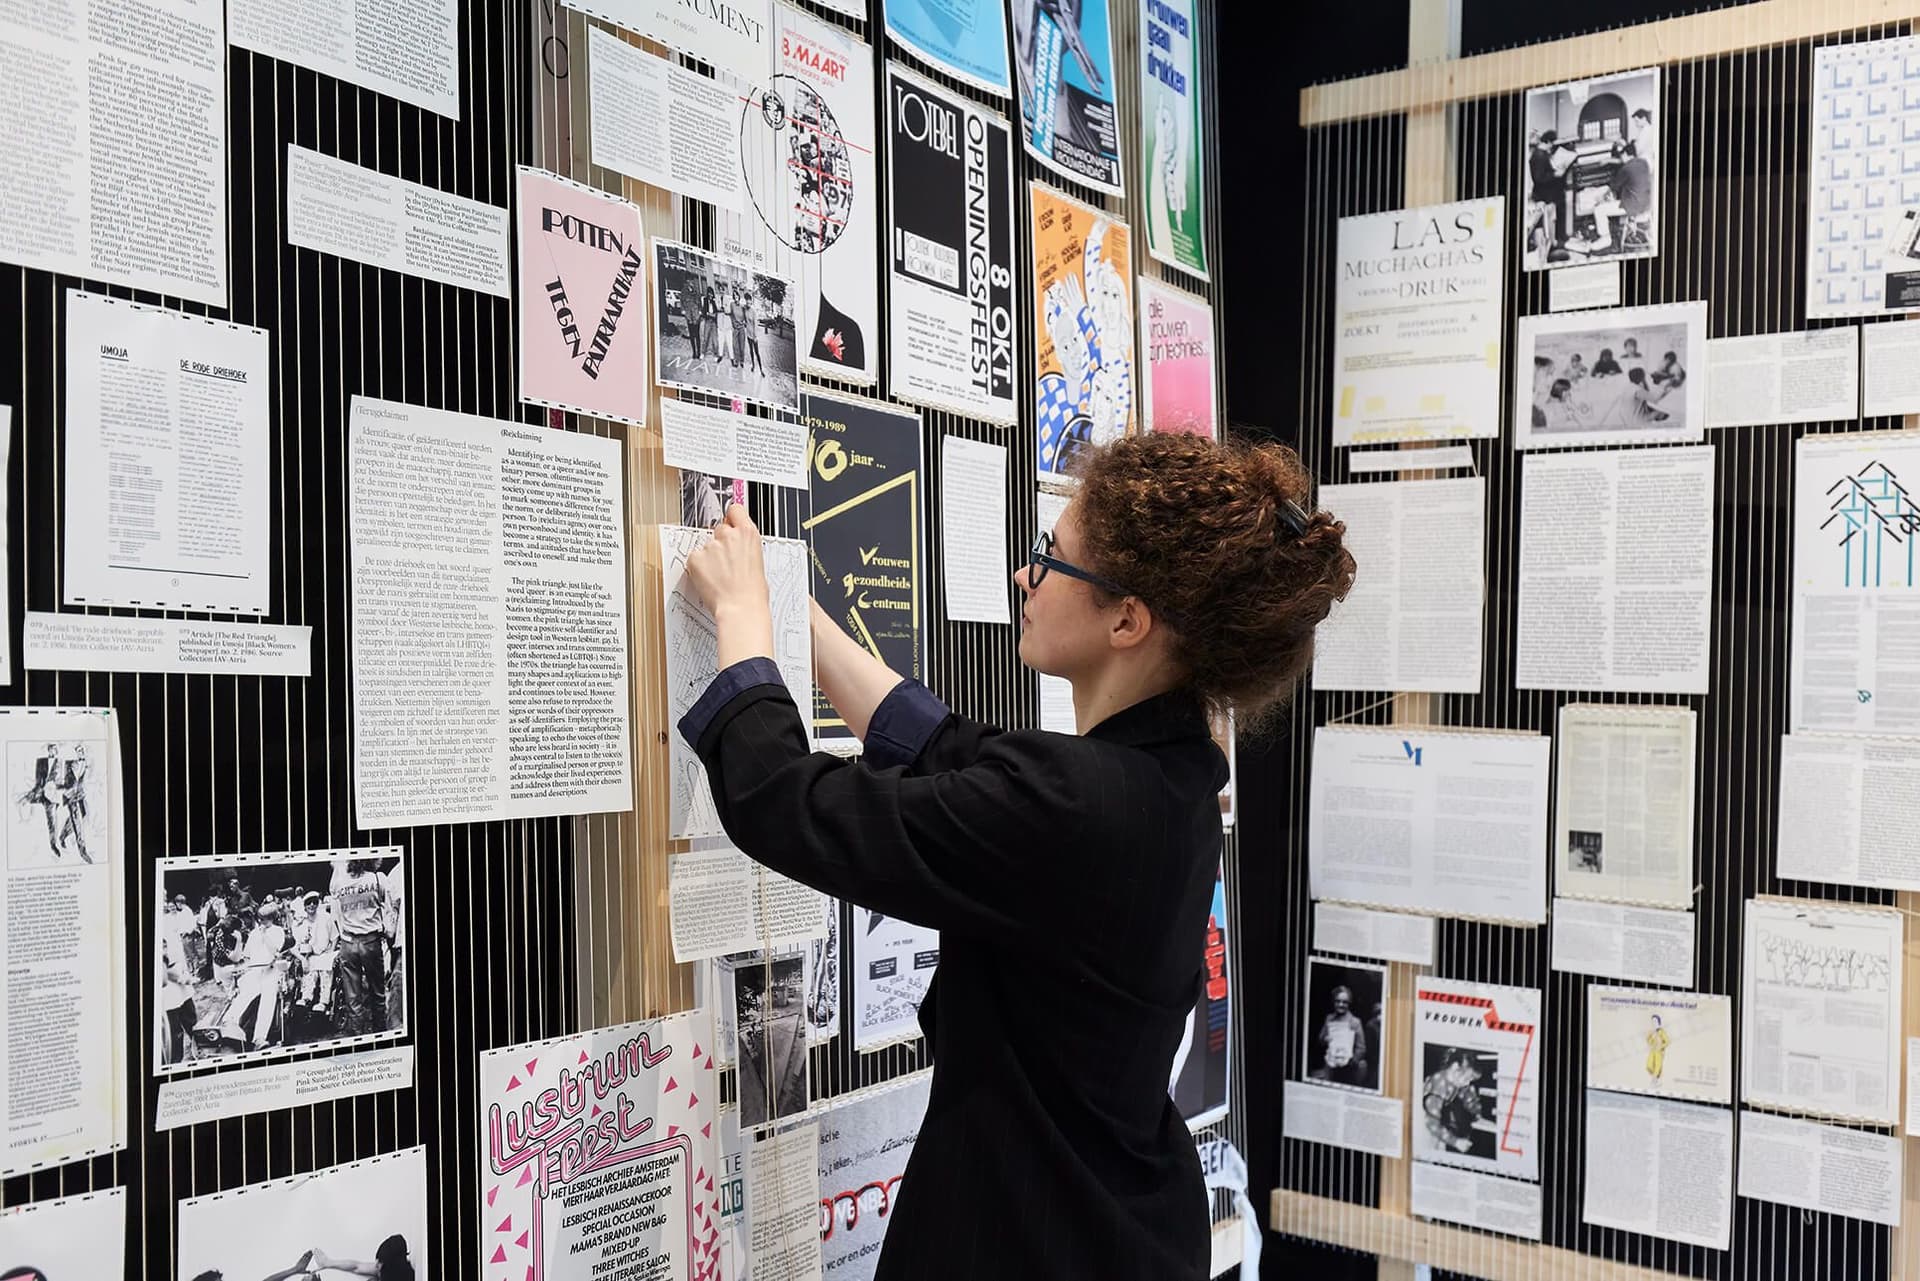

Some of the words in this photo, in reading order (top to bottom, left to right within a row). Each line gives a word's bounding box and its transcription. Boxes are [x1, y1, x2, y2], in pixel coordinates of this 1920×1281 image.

[1147, 19, 1171, 53] gaan
[792, 44, 846, 82] MAART
[1147, 49, 1186, 97] drukken
[895, 85, 961, 160] TOTEBEL
[452, 203, 470, 213] Against
[542, 207, 624, 255] POTTEN
[1391, 211, 1475, 251] LAS
[967, 114, 988, 396] OPENINGSFEEST
[1343, 245, 1485, 281] MUCHACHAS
[989, 263, 1011, 289] 8
[1399, 278, 1460, 299] DRUK
[545, 275, 586, 359] TEGEN
[100, 344, 129, 359] UMOJA
[990, 306, 1012, 388] OKT.
[180, 359, 189, 369] DE
[192, 361, 211, 374] RODE
[213, 366, 248, 380] DRIEHOEK
[555, 456, 571, 465] being
[557, 465, 573, 473] queer
[850, 450, 874, 467] jaar
[502, 465, 523, 476] binary
[550, 474, 583, 484] oftentimes
[858, 543, 911, 569] Vrouwen
[512, 577, 525, 585] The
[526, 578, 540, 586] pink
[568, 582, 580, 590] just
[581, 582, 592, 590] like
[593, 583, 603, 591] the
[842, 572, 912, 598] gezondheids
[857, 590, 911, 611] Centrum
[545, 616, 559, 624] pink
[561, 617, 584, 626] triangle
[511, 791, 533, 799] names
[535, 790, 547, 798] and
[1424, 990, 1494, 1009] TECHNIESE
[1425, 1011, 1484, 1028] VROUWEN
[1489, 1020, 1534, 1035] KRANT
[307, 1068, 326, 1077] Group
[357, 1057, 402, 1068] Demonstration
[296, 1078, 310, 1086] Pink
[342, 1076, 373, 1086] Collection
[489, 1032, 673, 1175] Lustrum
[538, 1093, 653, 1199] Feest
[551, 1187, 567, 1200] HET
[567, 1176, 603, 1194] LESBISCH
[602, 1167, 634, 1188] ARCHIEF
[633, 1154, 680, 1180] AMSTERDAM
[562, 1194, 586, 1208] VIERT
[585, 1188, 606, 1203] HAAR
[605, 1174, 654, 1197] VERJAARDAG
[654, 1169, 671, 1183] MET:
[562, 1210, 599, 1228] LESBISCH
[598, 1186, 672, 1216] RENAISSANCEKOOR
[581, 1219, 611, 1237] SPECIAL
[610, 1205, 655, 1229] OCCASION
[570, 1236, 603, 1255] MAMA'S
[604, 1226, 631, 1243] BRAND
[632, 1219, 650, 1234] NEW
[651, 1214, 666, 1228] BAG
[601, 1237, 640, 1258] MIXED-UP
[592, 1257, 616, 1275] THREE
[616, 1247, 649, 1266] WITCHES
[848, 1250, 859, 1260] en
[859, 1241, 881, 1257] door
[610, 1262, 645, 1280] LITERAIRE
[646, 1252, 670, 1270] SALON
